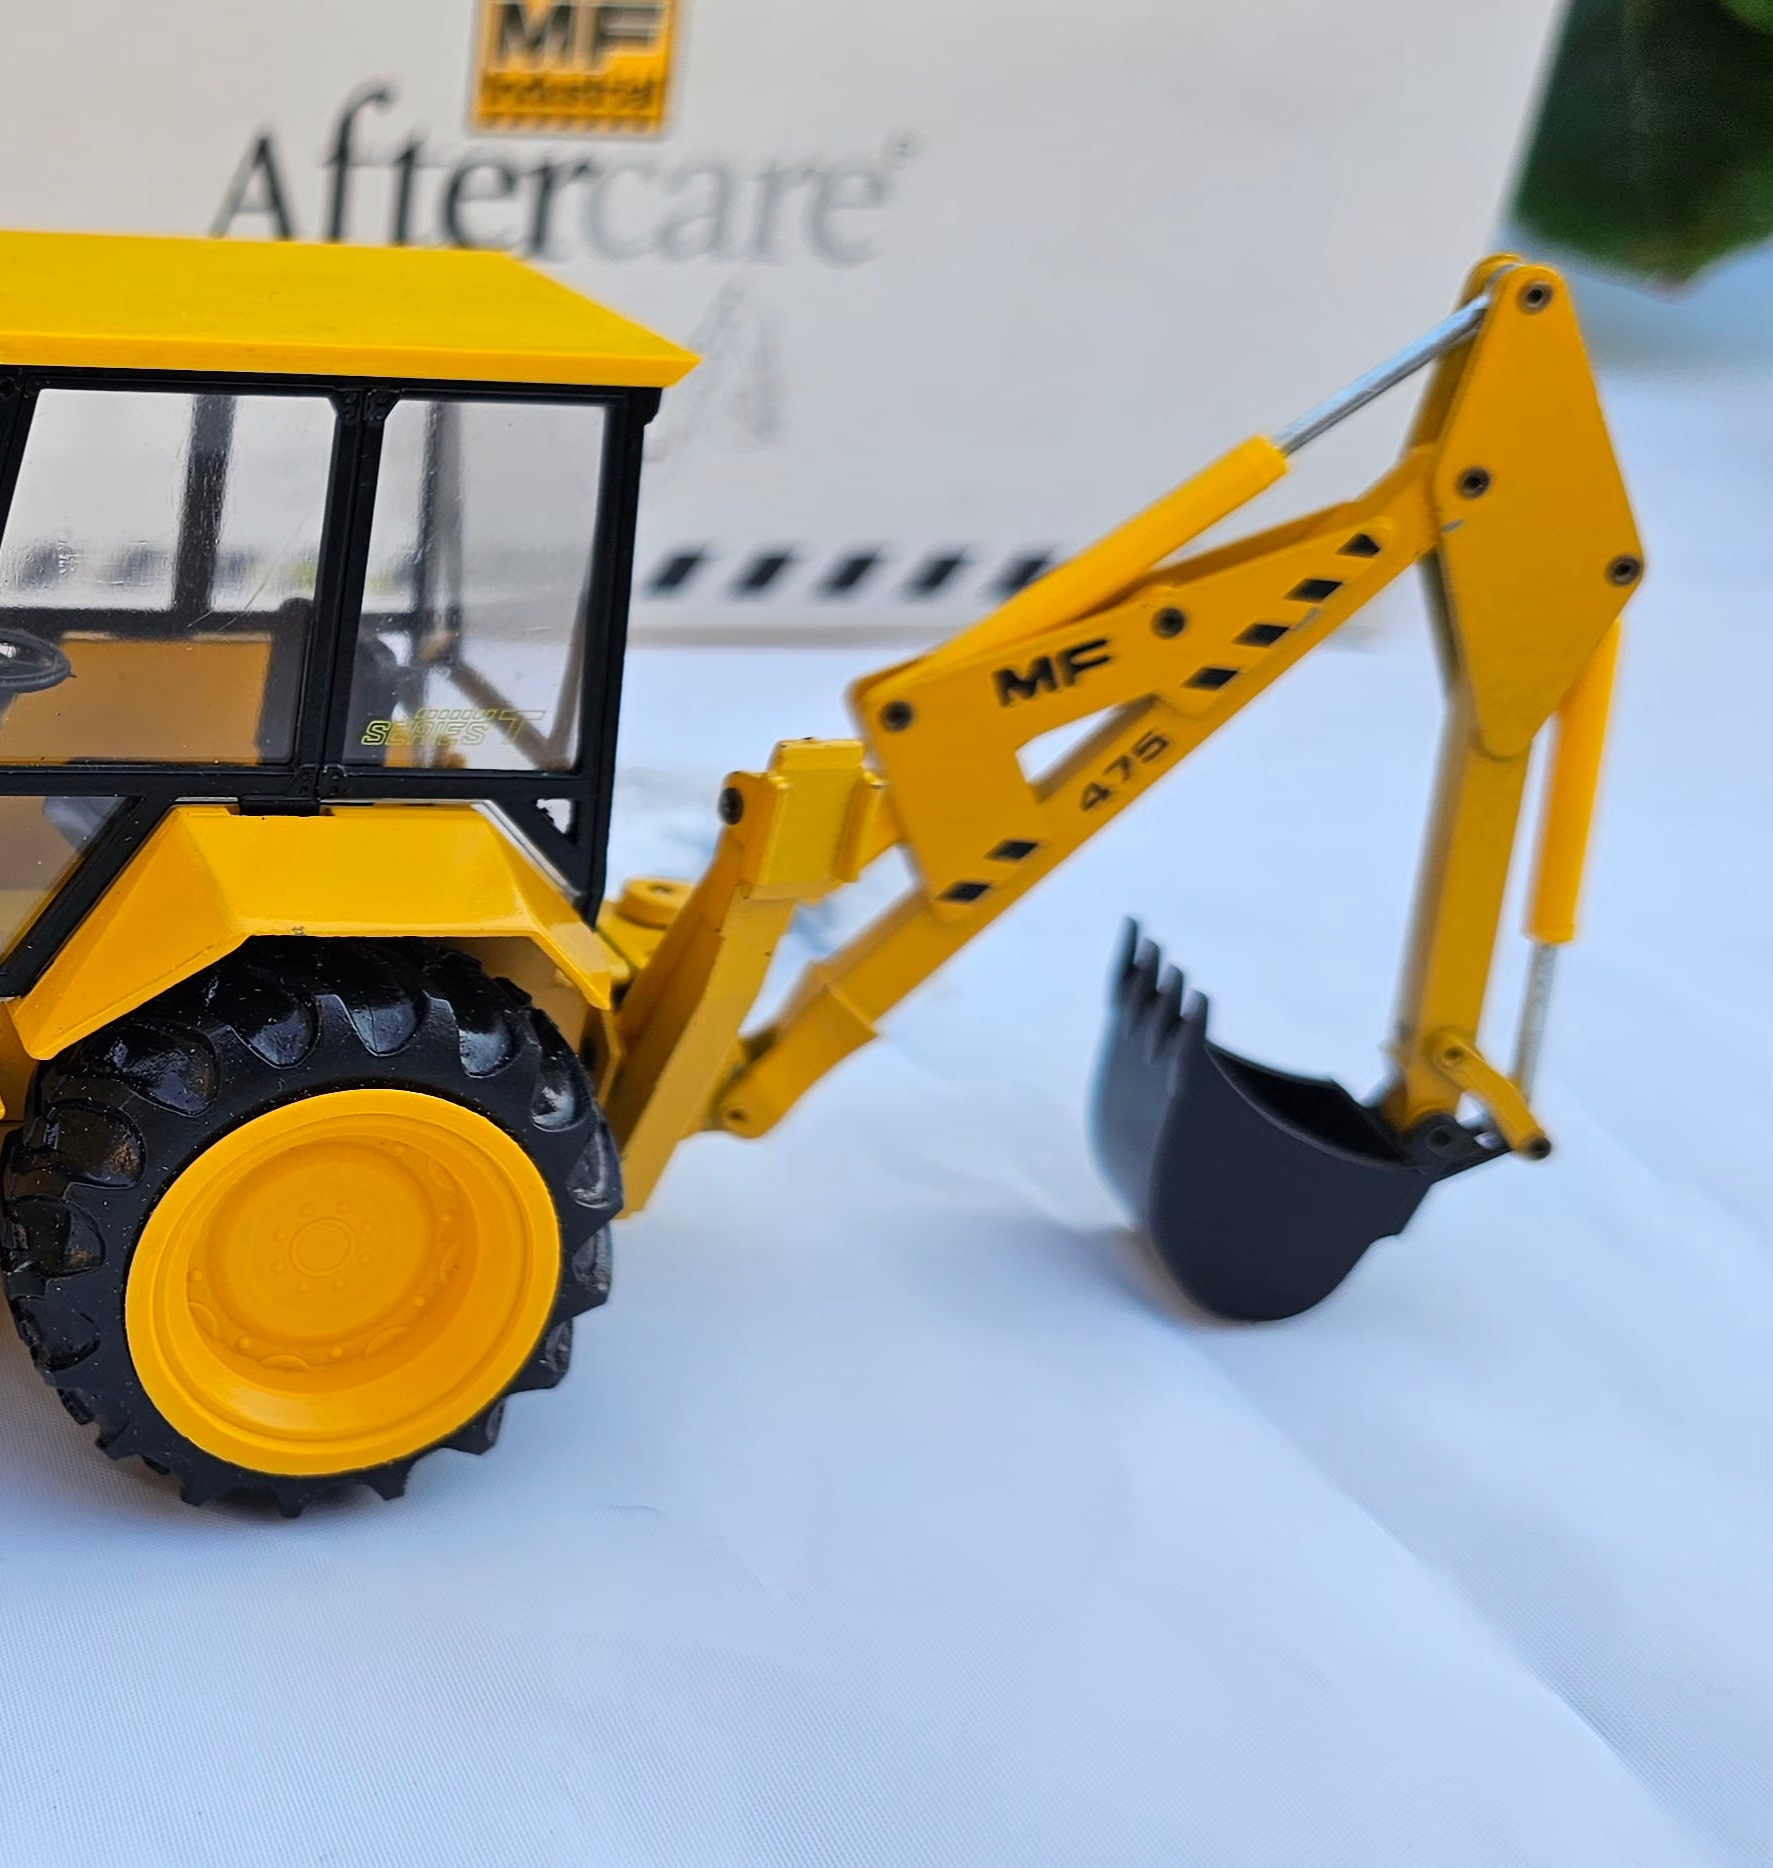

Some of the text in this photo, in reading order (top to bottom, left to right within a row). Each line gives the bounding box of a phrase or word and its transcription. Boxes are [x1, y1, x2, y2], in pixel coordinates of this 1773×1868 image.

[493, 2, 665, 68] MF
[208, 78, 889, 268] Aftercare
[992, 637, 1114, 708] MF
[361, 719, 489, 746] SERIES
[1080, 727, 1171, 813] 475
